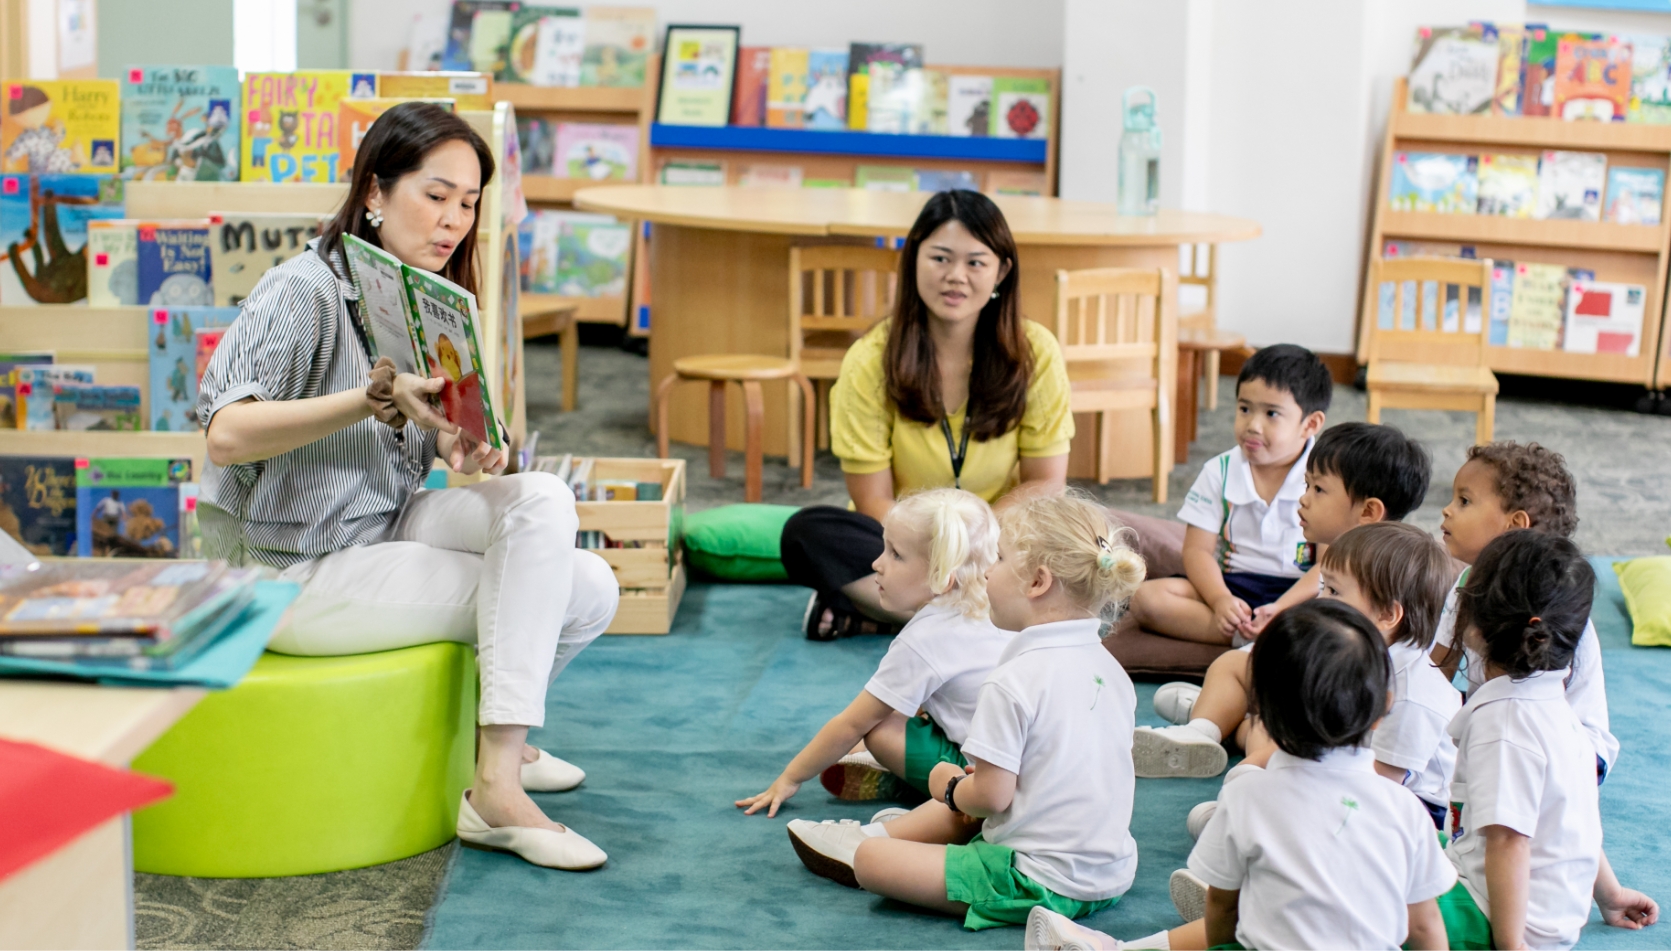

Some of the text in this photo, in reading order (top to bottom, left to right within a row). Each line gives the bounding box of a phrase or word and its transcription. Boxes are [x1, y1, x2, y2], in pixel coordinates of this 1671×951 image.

[62, 85, 109, 105] Harry
[248, 75, 319, 109] FAIRY
[301, 111, 340, 149] TA
[422, 297, 457, 328] 我喜欢书
